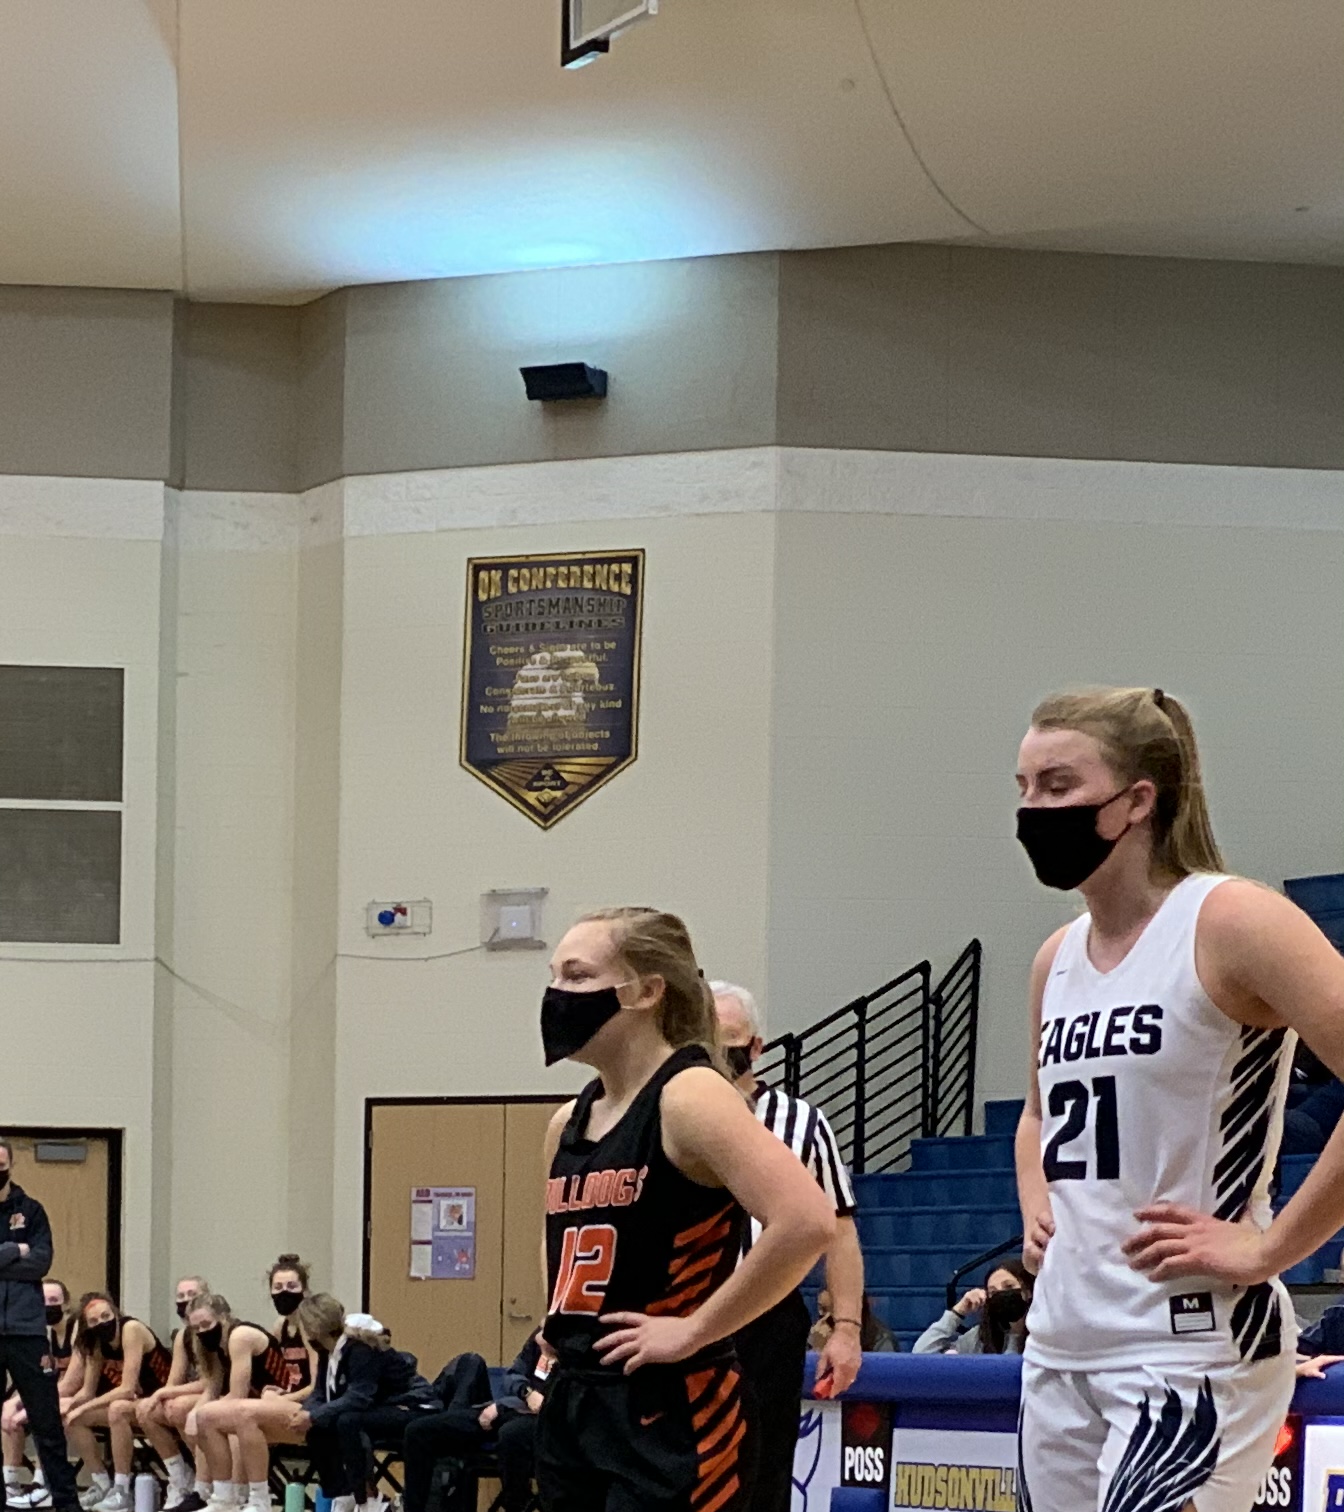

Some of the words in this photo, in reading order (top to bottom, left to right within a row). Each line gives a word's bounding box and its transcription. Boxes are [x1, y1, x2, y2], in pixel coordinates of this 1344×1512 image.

[508, 563, 632, 595] CONFERENCE
[483, 617, 624, 633] GUIDELINES
[484, 597, 626, 618] SPORTSMANSHIP
[1043, 1075, 1120, 1183] 21
[546, 1165, 648, 1214] ULLDOGS
[548, 1224, 617, 1316] 12
[1182, 1297, 1200, 1310] M
[844, 1446, 884, 1482] POSS
[1255, 1466, 1292, 1507] OSS
